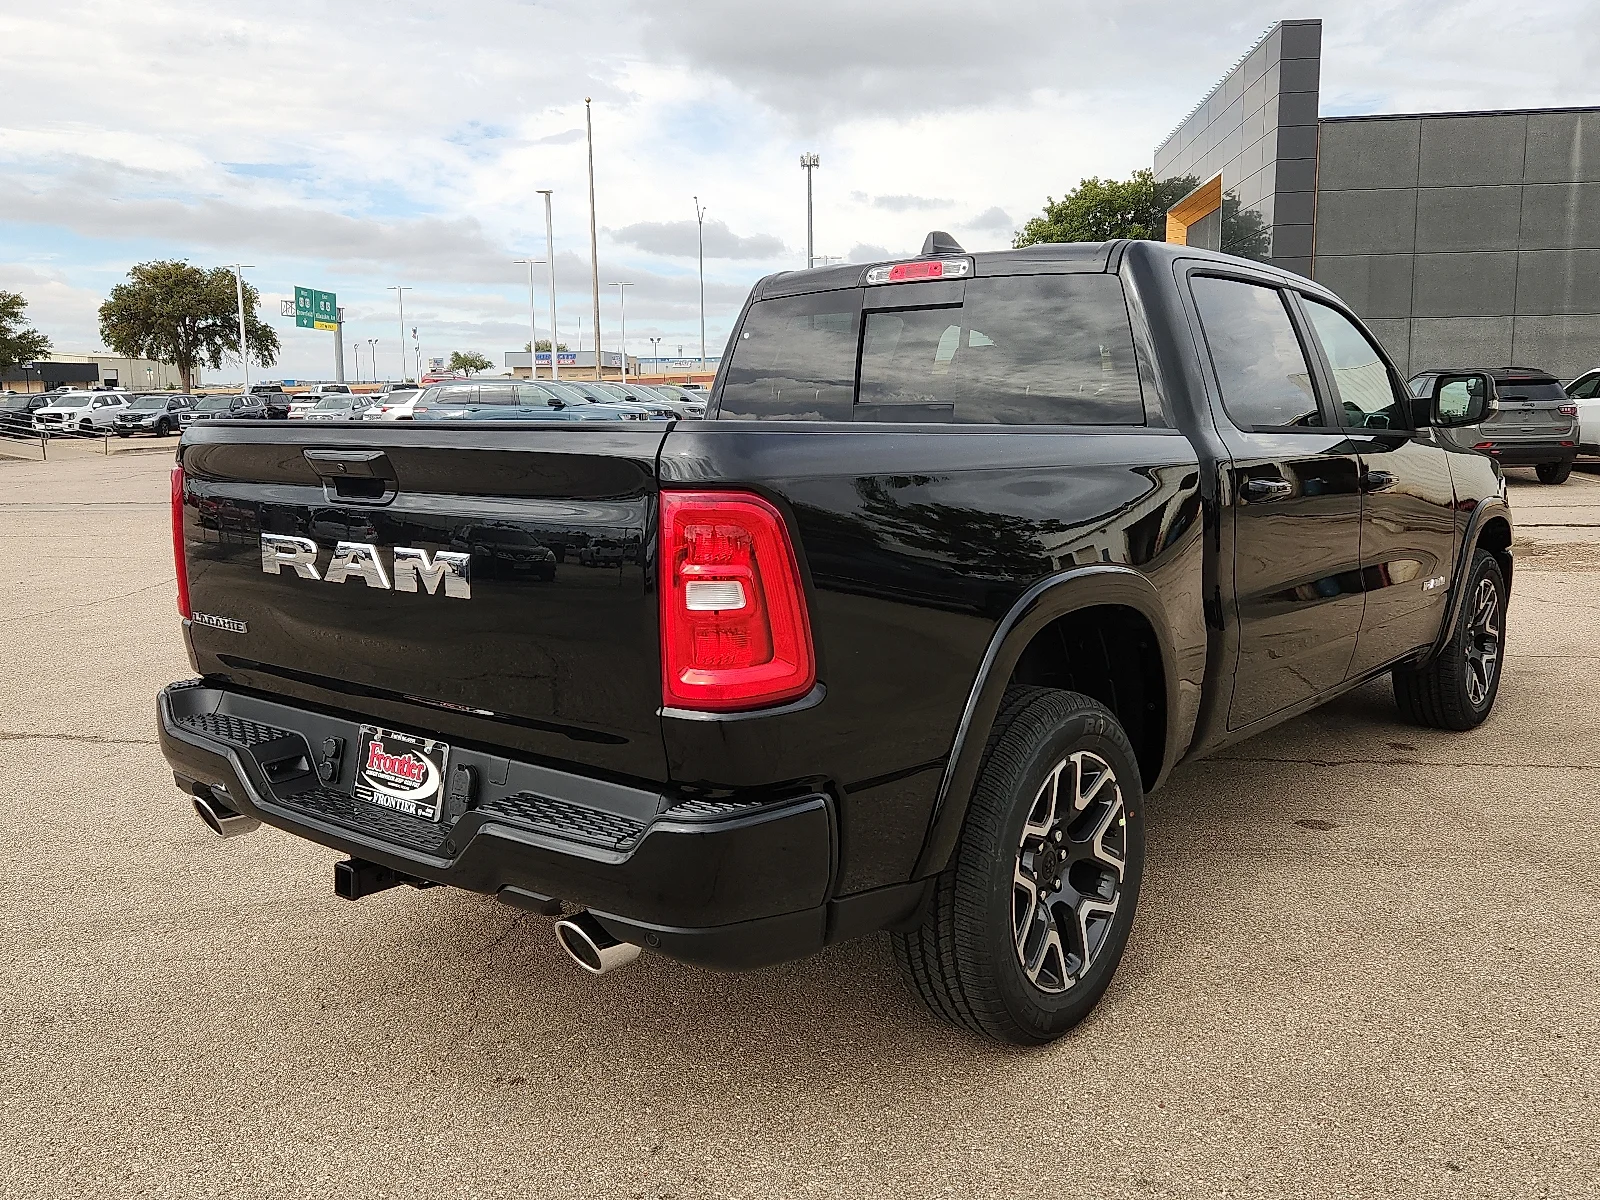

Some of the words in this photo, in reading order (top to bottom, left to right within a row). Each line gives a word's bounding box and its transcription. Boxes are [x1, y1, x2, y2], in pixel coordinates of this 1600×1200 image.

[260, 532, 472, 599] RAM
[366, 741, 426, 782] Frontier
[373, 792, 417, 815] FRONTIER
